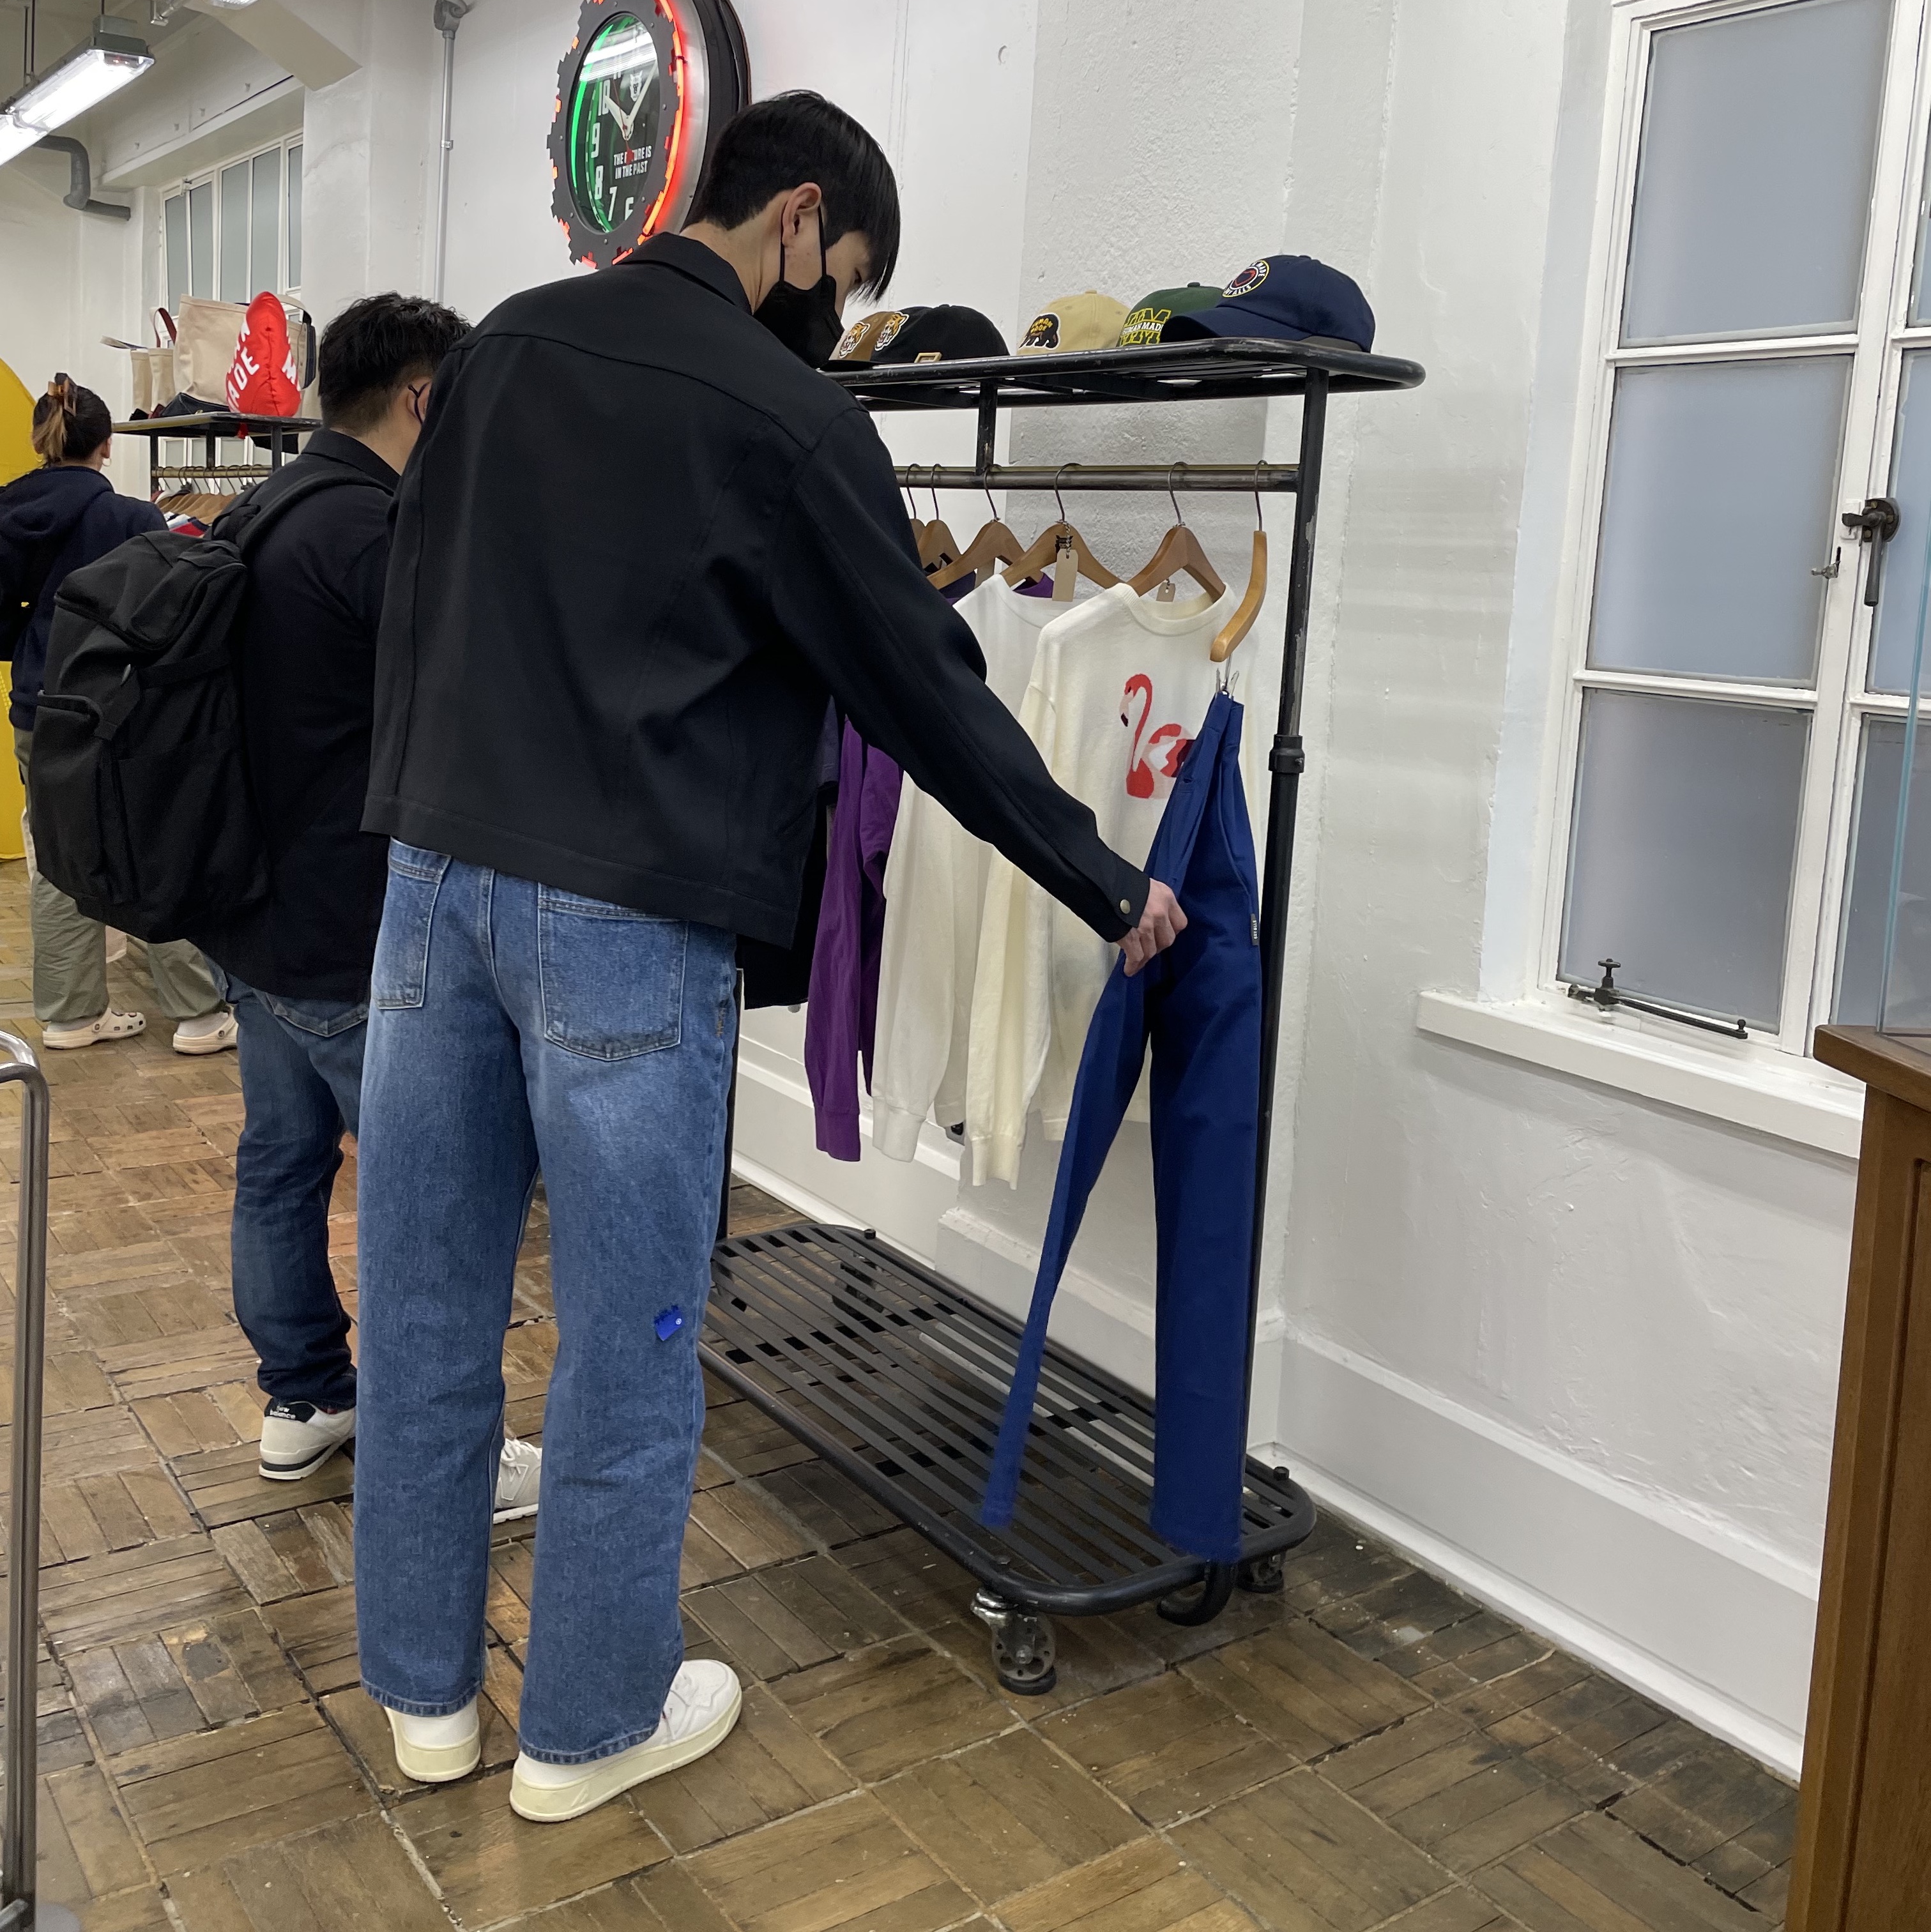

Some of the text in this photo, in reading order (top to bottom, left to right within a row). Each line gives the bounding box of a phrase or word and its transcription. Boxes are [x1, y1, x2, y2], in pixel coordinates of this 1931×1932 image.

[591, 122, 600, 158] 9
[614, 153, 623, 166] THE
[645, 145, 652, 158] IS
[595, 165, 604, 200] 8
[615, 160, 648, 179] IN THE PAST
[608, 186, 618, 222] 7
